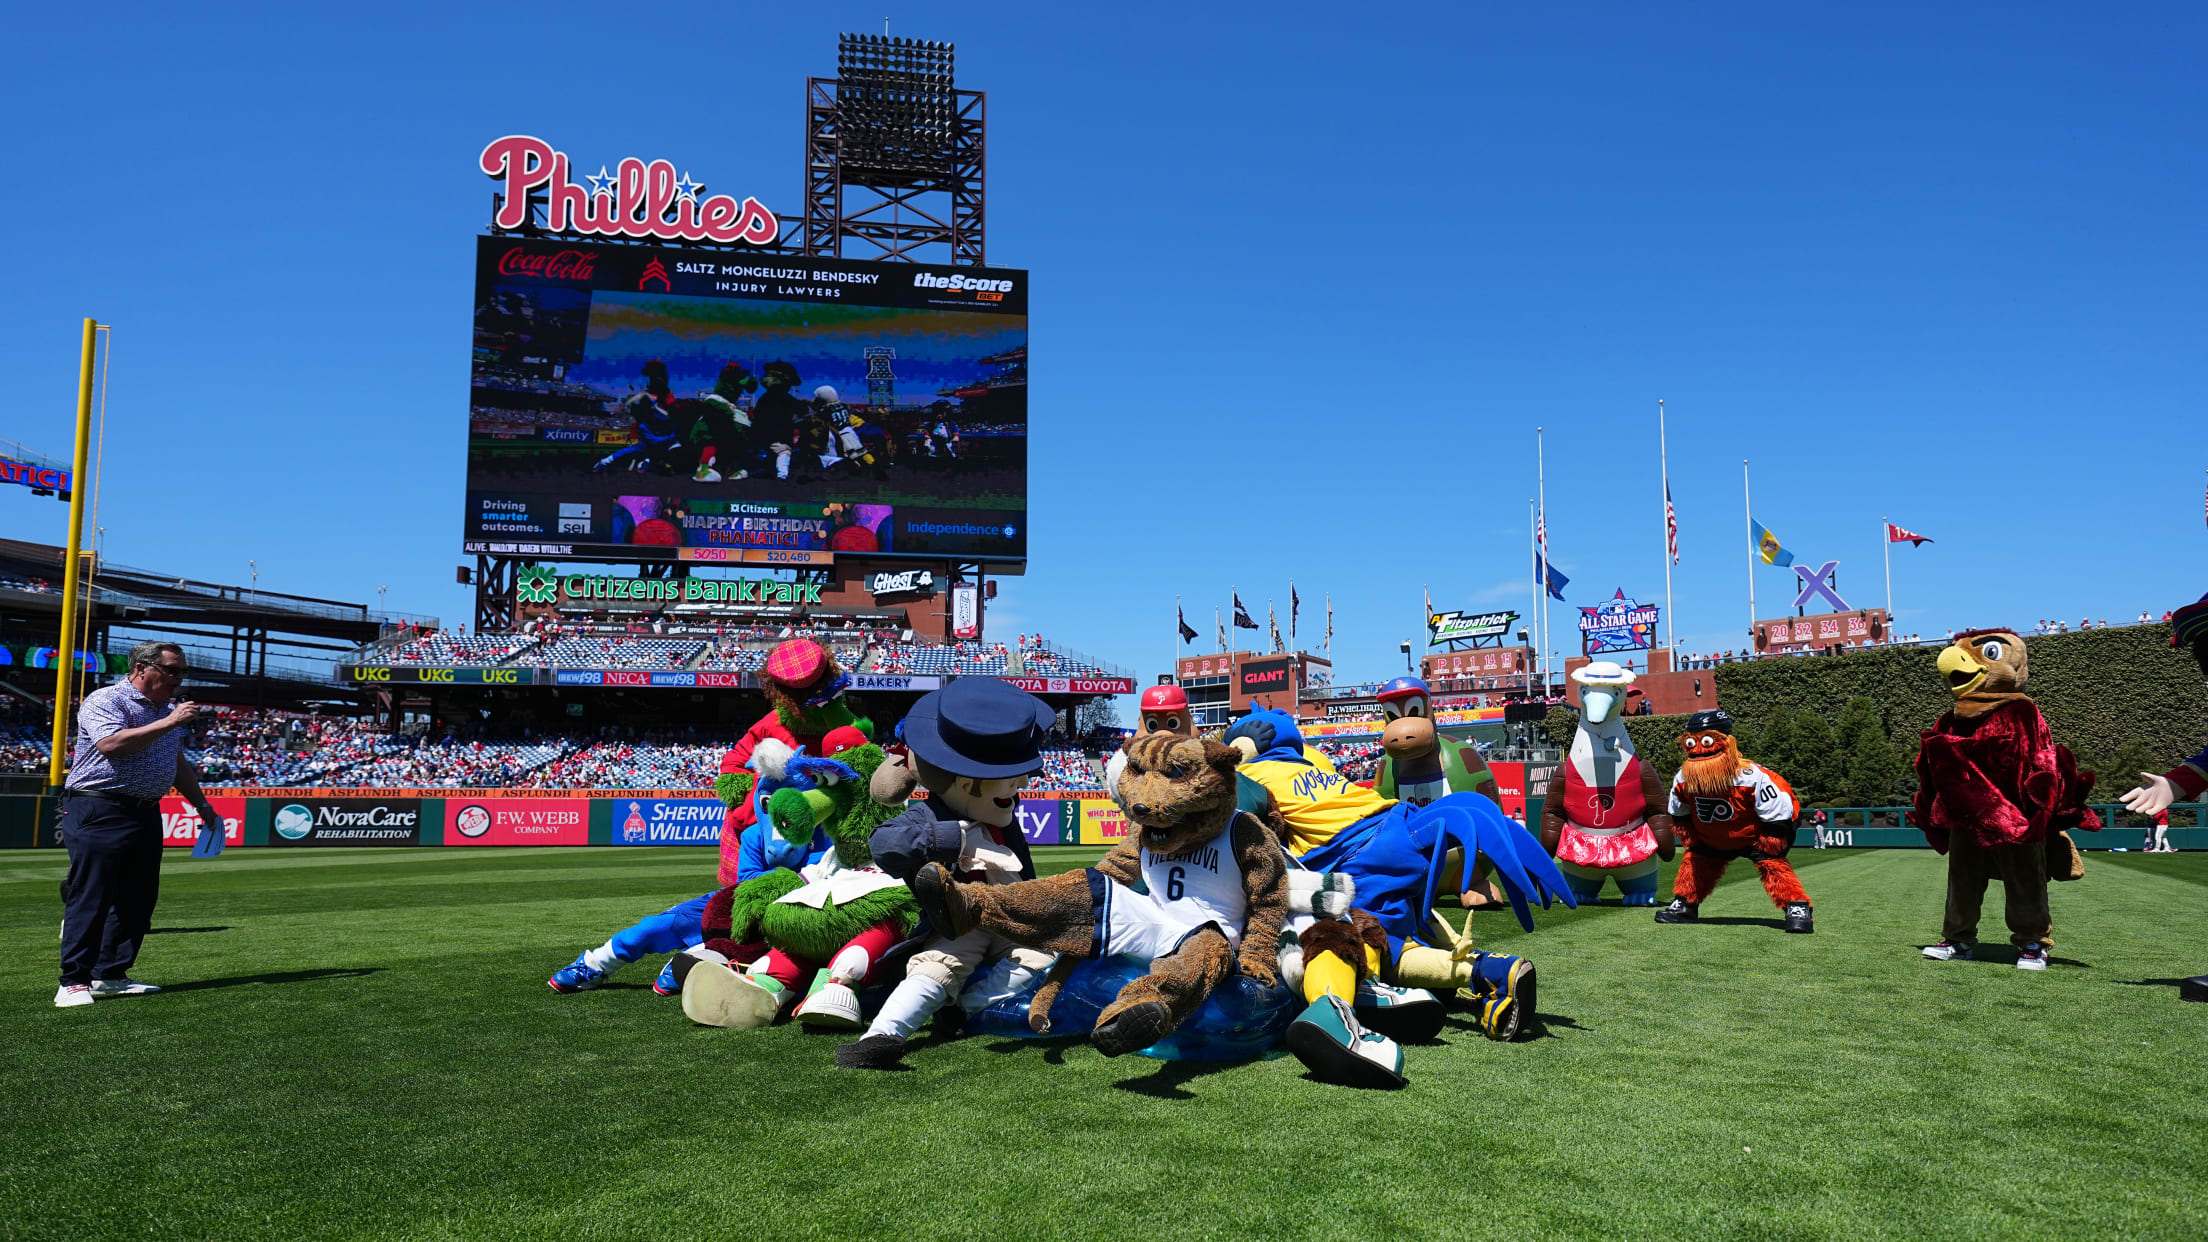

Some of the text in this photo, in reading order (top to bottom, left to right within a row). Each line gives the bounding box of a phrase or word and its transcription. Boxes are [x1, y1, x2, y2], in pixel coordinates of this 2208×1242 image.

[479, 135, 778, 245] Phillies
[676, 262, 879, 285] SALTZ MONGELUZZI BENDESKY
[914, 272, 1013, 293] theScore
[716, 281, 841, 298] INJURY LAWYERS
[979, 293, 1001, 301] BET
[482, 500, 526, 512] Driving
[740, 503, 779, 514] Citizens
[482, 512, 528, 521] smarter
[482, 523, 543, 533] outcomes.
[682, 515, 824, 533] HAPPY BIRTHDAY
[907, 521, 998, 536] Independence
[709, 530, 799, 546] PHANATIC!
[767, 552, 811, 562] $20,480
[563, 574, 822, 603] Citizens Bank Park
[873, 570, 919, 595] GHOST
[1435, 612, 1510, 633] Fitzpatrick
[1580, 611, 1658, 630] ALL STAR GAME
[1821, 619, 1838, 633] 34
[1848, 617, 1865, 631] 36
[1772, 624, 1788, 638] 20
[1795, 622, 1811, 636] 32
[1219, 658, 1227, 669] P
[1438, 658, 1447, 670] P
[1485, 653, 1495, 665] 14
[1501, 652, 1512, 663] 15
[1185, 662, 1193, 673] P
[1202, 660, 1211, 671] P
[354, 667, 391, 681] UKG
[418, 668, 454, 682] UKG
[482, 669, 518, 683] UKG
[606, 673, 647, 684] NECA
[699, 674, 738, 686] NECA
[1244, 670, 1285, 684] GIANT
[857, 677, 911, 688] BAKERY
[1074, 680, 1127, 691] TOYOTA
[1434, 713, 1462, 725] urfside
[1334, 724, 1368, 737] Surfside
[239, 789, 313, 797] ASPLUNDH
[329, 789, 401, 797] ASPLUNDH
[416, 789, 487, 798] ASPLUNDH
[501, 790, 571, 798] ASPLUNDH
[585, 790, 654, 798] ASPLUNDH
[668, 790, 717, 798] ASPLUN
[1498, 786, 1521, 796] here.
[1531, 781, 1549, 796] ANGL
[1760, 785, 1777, 803] 00
[315, 806, 413, 826] NovaCare
[496, 811, 580, 825] F.W. WEBB
[1087, 809, 1105, 818] WHO
[1065, 801, 1074, 843] 374
[315, 829, 412, 839] REHABILITATION
[514, 826, 560, 834] COMPANY
[649, 822, 721, 841] WILLIAM
[1824, 830, 1852, 846] 401
[1167, 866, 1185, 901] 6
